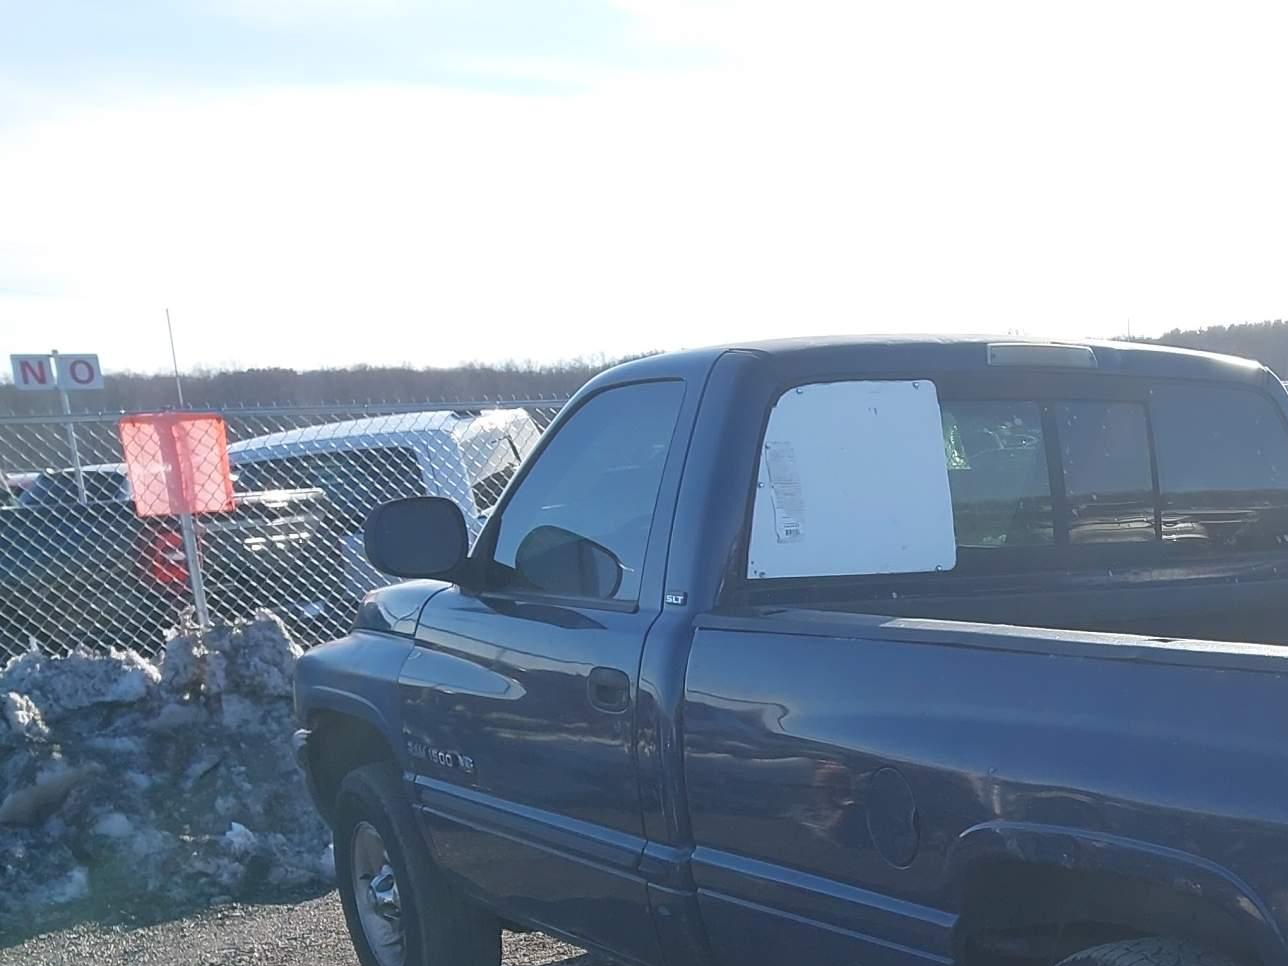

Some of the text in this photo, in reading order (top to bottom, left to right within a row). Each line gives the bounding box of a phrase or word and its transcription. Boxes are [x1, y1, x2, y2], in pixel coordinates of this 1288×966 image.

[19, 359, 47, 385] N
[69, 359, 95, 385] O
[665, 594, 684, 604] SLT
[427, 748, 453, 767] 1500
